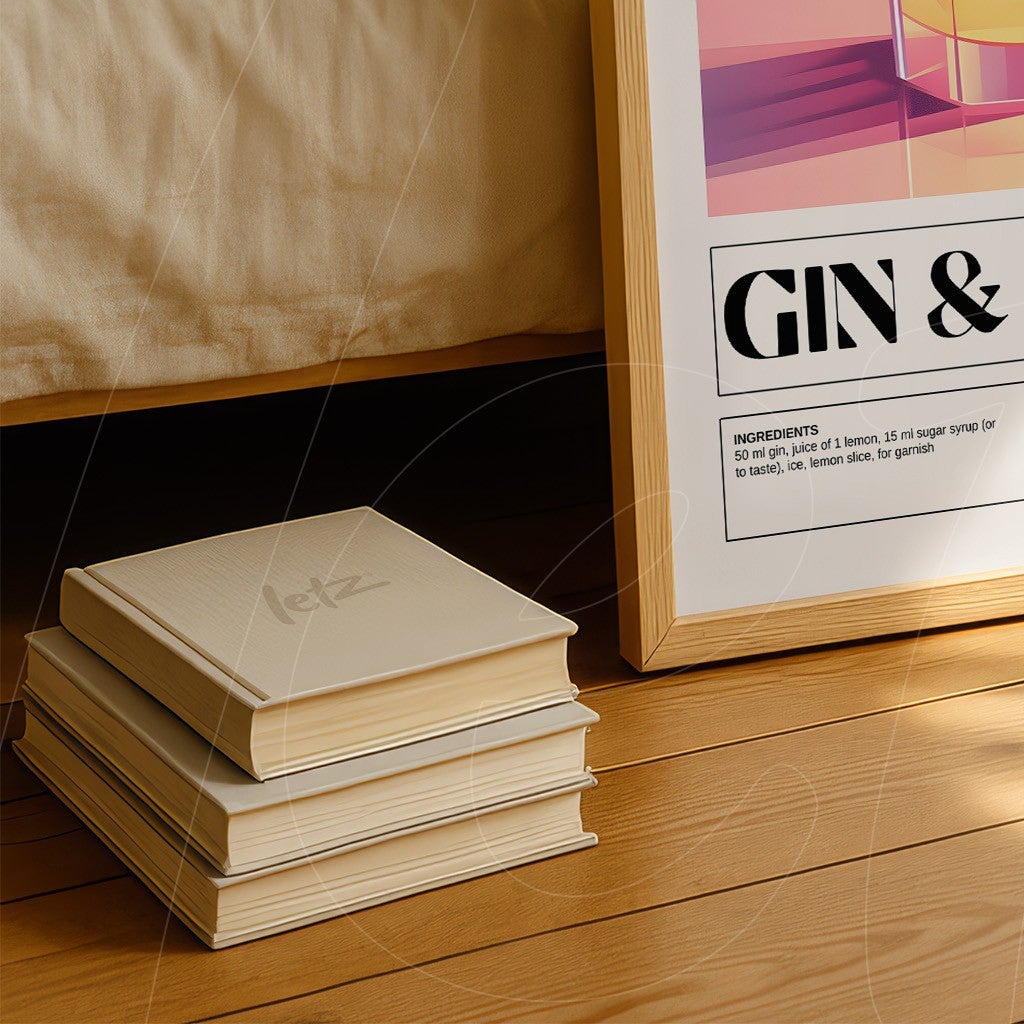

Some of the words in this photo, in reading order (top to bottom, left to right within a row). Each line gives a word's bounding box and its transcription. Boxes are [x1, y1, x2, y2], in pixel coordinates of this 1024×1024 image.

[724, 258, 897, 360] GIN
[926, 250, 1008, 339] &
[734, 425, 819, 445] INGREDIENTS
[735, 450, 749, 461] 50
[753, 447, 765, 459] ml
[769, 445, 789, 460] gin,
[791, 442, 817, 457] juice
[821, 439, 832, 451] of
[835, 438, 841, 449] 1
[844, 433, 881, 448] lemon,
[885, 431, 898, 443] 15
[901, 428, 914, 440] ml
[916, 425, 946, 442] sugar
[950, 421, 979, 436] syrup
[982, 418, 996, 432] (or
[735, 466, 746, 477] to
[750, 462, 784, 476] taste),
[787, 458, 806, 472] ice,
[810, 454, 843, 468] lemon
[847, 450, 875, 464] slice,
[877, 447, 891, 459] for
[895, 442, 935, 459] garnish
